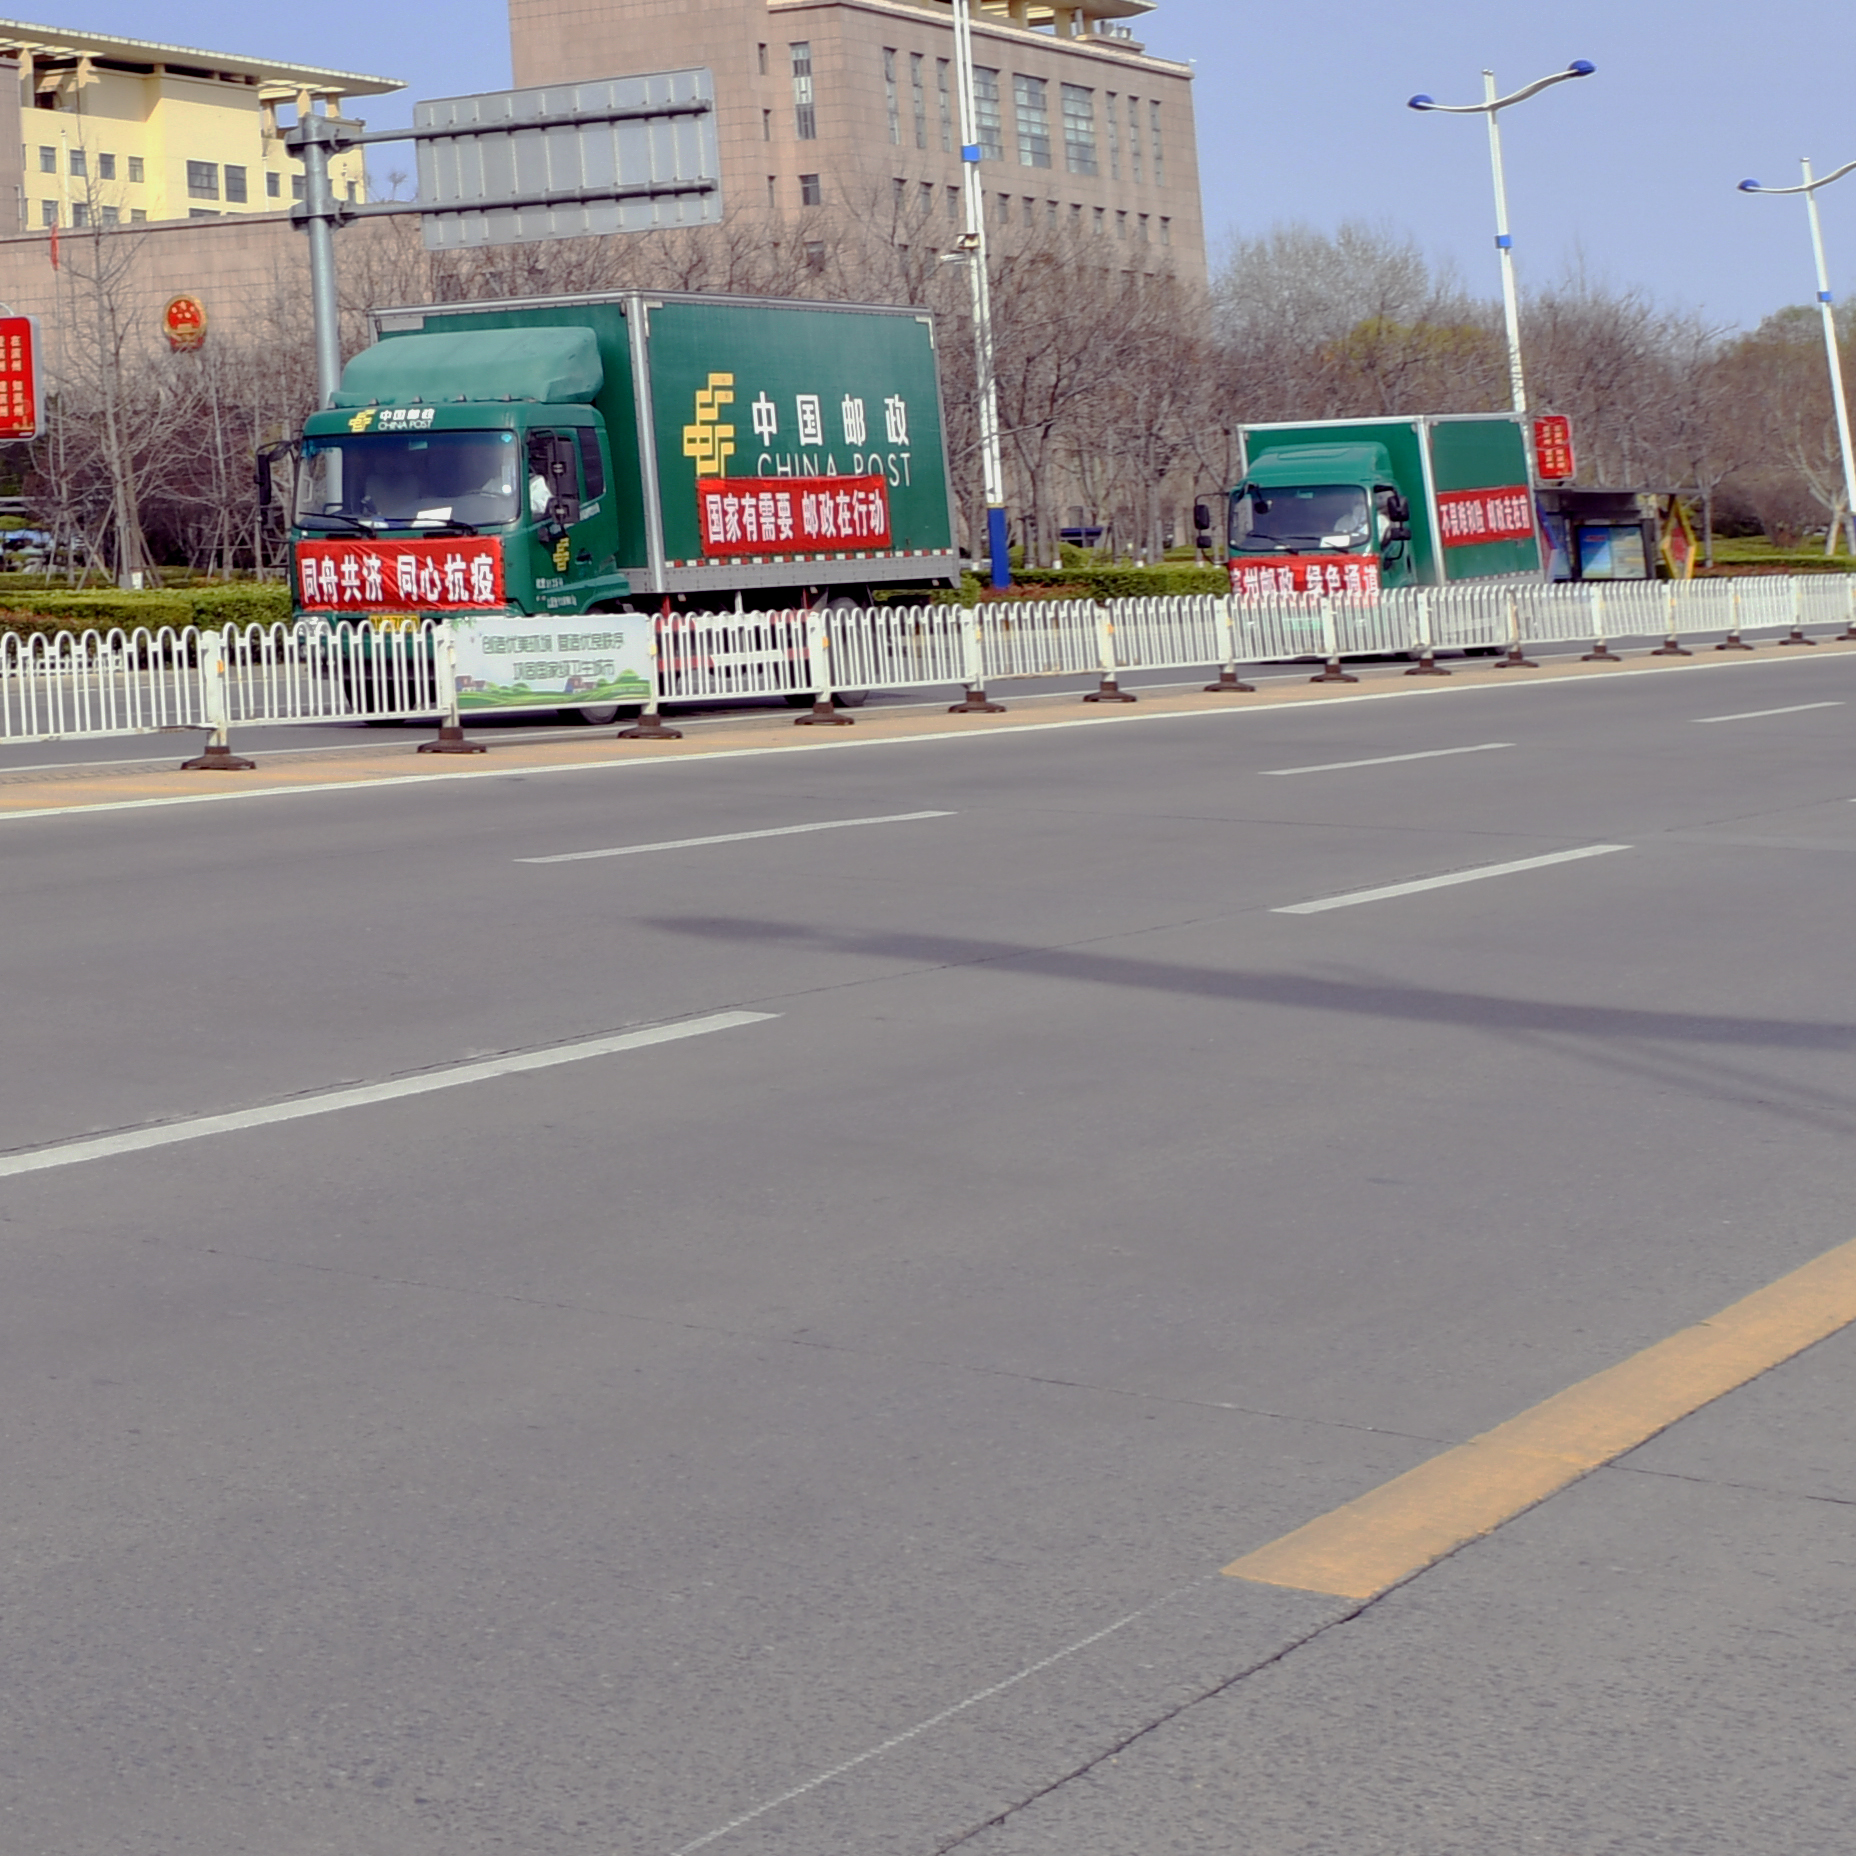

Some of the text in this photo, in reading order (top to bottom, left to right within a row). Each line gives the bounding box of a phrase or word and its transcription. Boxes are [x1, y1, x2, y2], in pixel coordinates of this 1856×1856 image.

[752, 391, 910, 447] 中国邮政
[757, 452, 911, 487] CHINA POST
[705, 488, 885, 544] 国家有需要 邮政在行动
[301, 552, 495, 603] 同舟共济 同心抗疫
